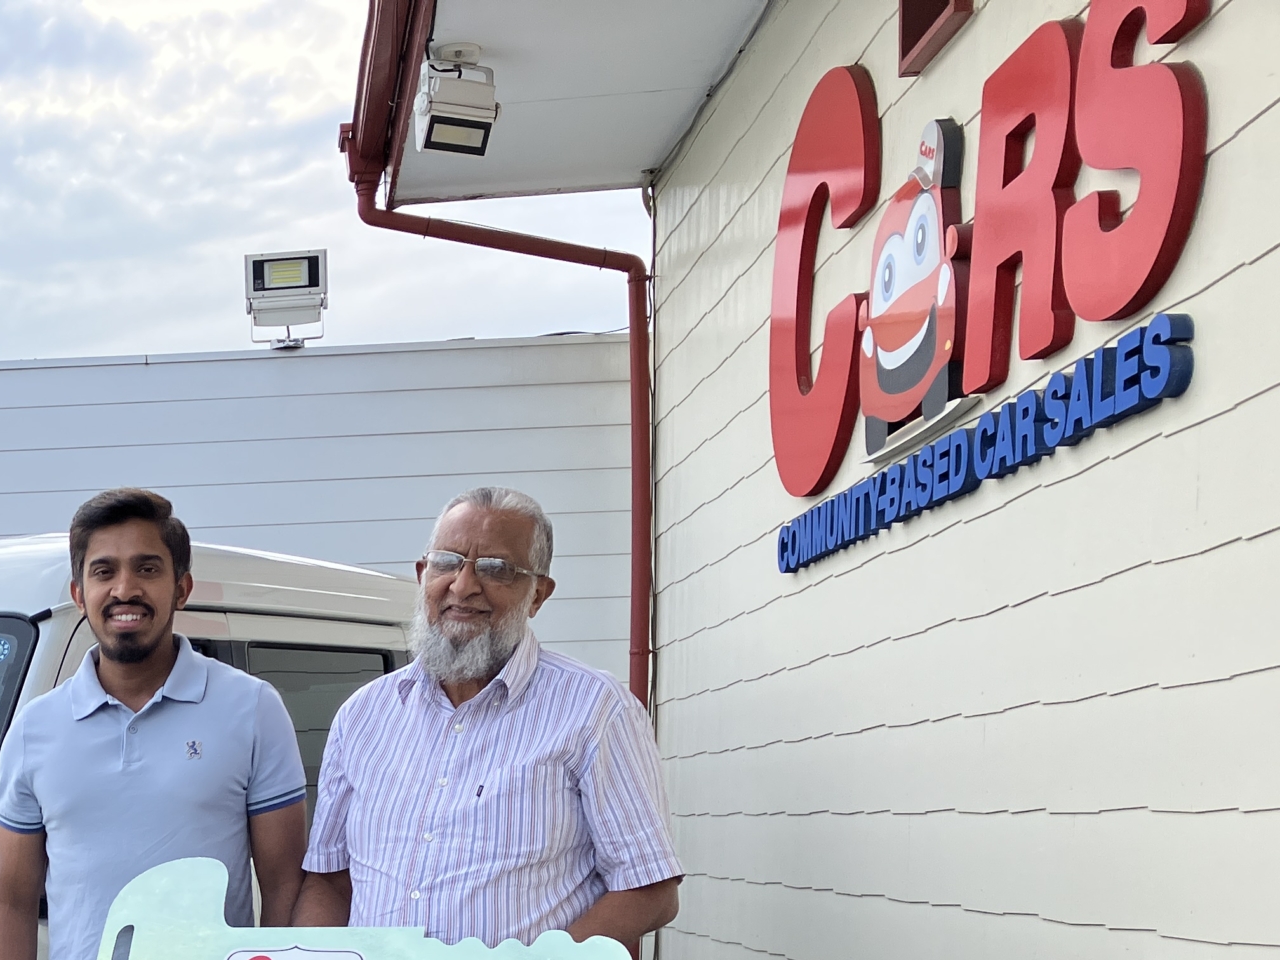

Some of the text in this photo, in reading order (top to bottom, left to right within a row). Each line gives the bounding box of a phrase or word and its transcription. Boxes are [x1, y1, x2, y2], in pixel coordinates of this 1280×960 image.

[770, 0, 1208, 497] CRS
[778, 314, 1192, 573] COMMUNITY-BASED CAR SALES
